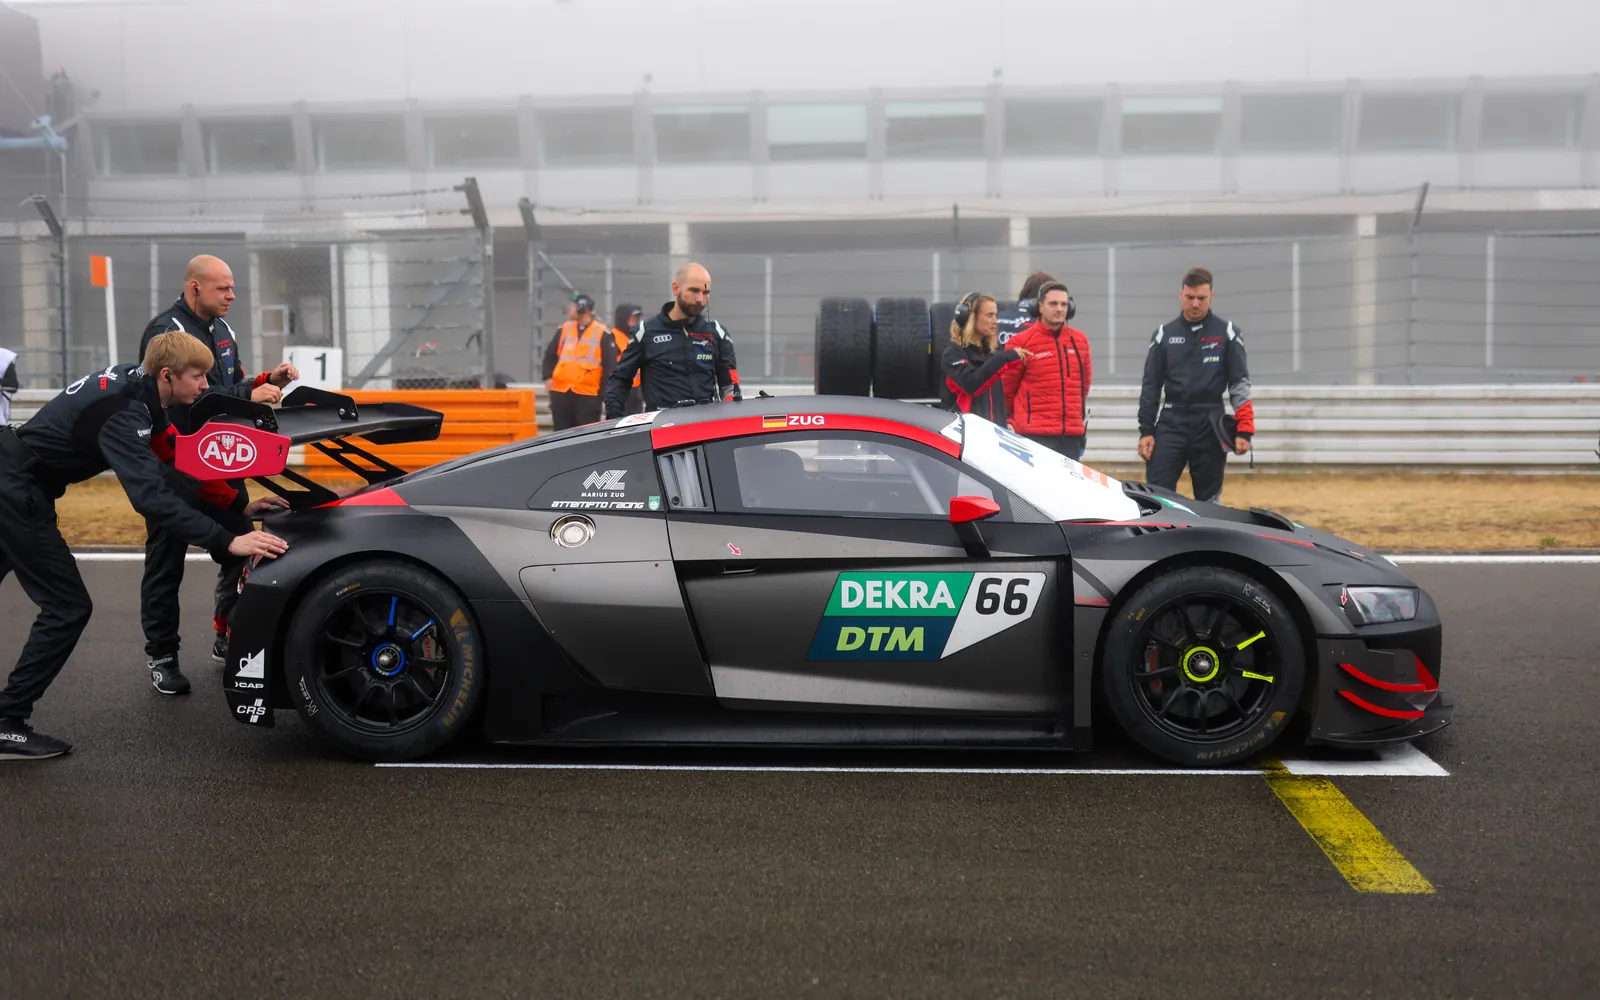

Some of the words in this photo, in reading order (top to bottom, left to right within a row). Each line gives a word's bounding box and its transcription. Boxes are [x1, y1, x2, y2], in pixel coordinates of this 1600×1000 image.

[314, 352, 327, 381] 1
[788, 415, 825, 426] ZUG
[841, 580, 956, 609] DEKRA
[975, 577, 1030, 615] 66
[836, 626, 924, 652] DTM
[236, 705, 266, 716] CRS
